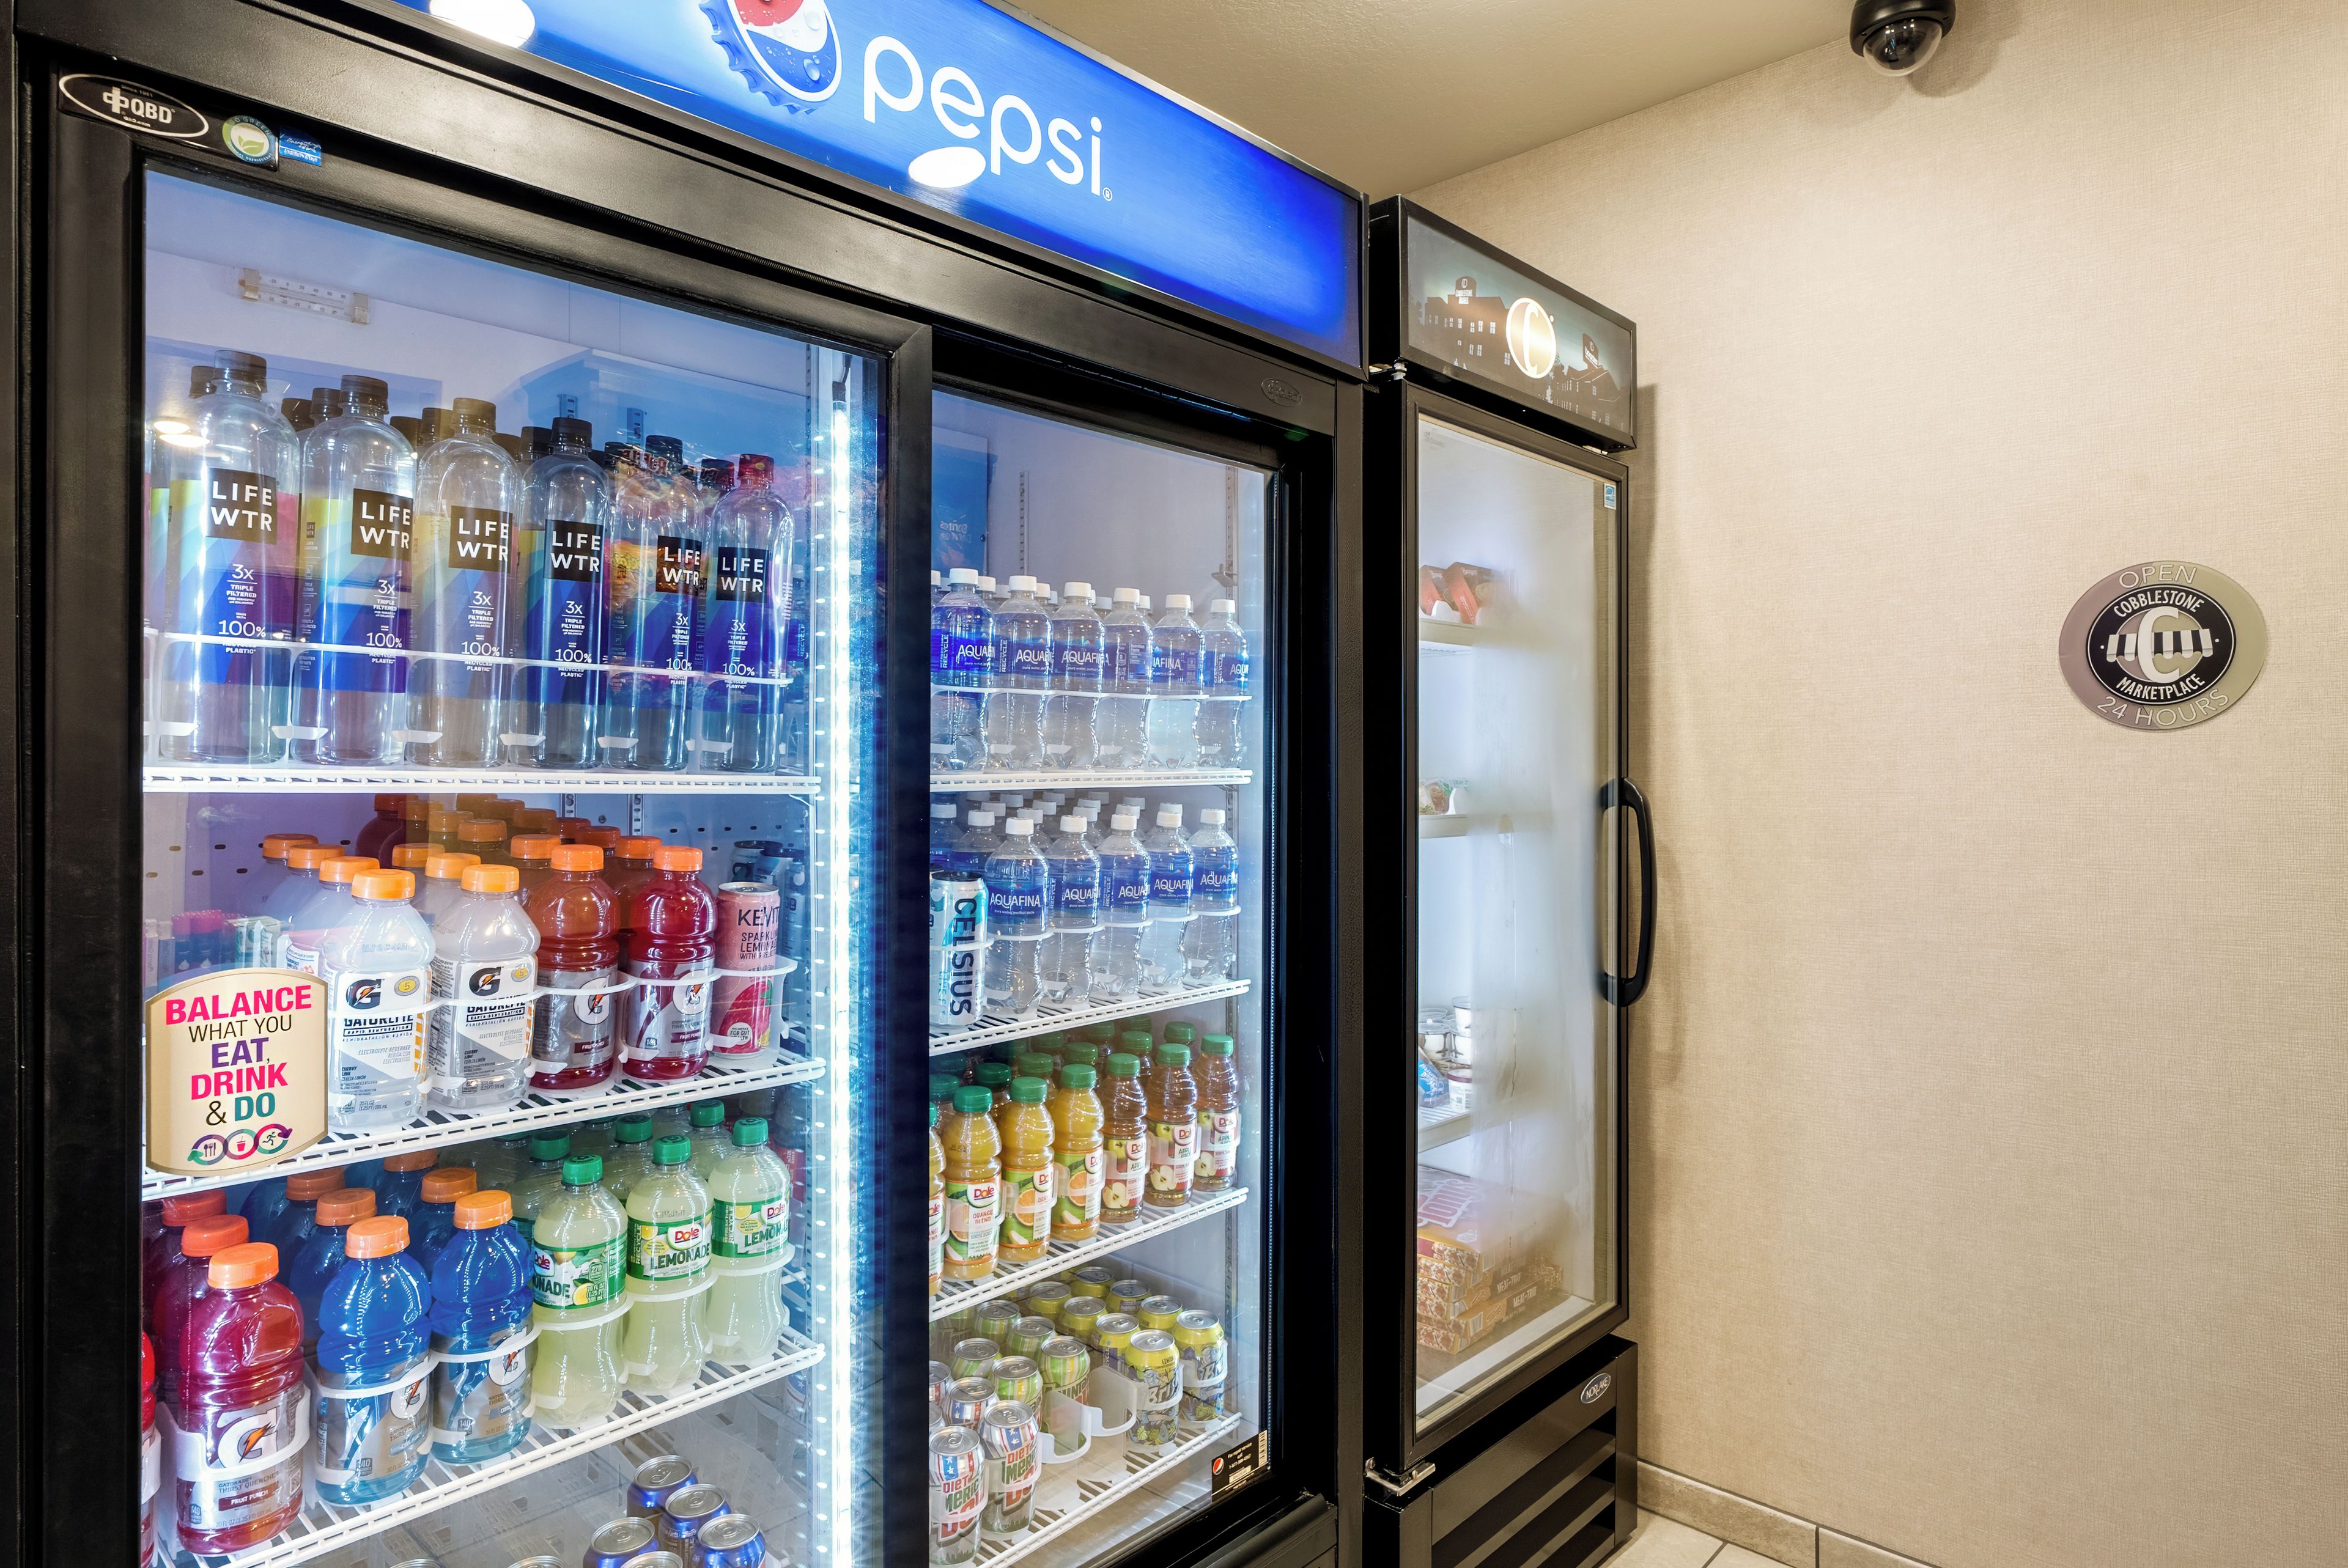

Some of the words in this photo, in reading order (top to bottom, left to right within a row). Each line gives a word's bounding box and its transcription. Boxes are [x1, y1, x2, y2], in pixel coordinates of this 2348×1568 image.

[130, 98, 172, 124] QBD
[863, 35, 1102, 196] pepsi
[212, 480, 272, 507] LIFE
[210, 506, 272, 532] WTR
[361, 501, 411, 526] LIFE
[360, 525, 410, 549] WTR
[459, 518, 509, 539] LIFE
[457, 540, 508, 562] WTR
[552, 531, 601, 551] LIFE
[550, 553, 600, 573] WTR
[664, 547, 700, 565] LIFE
[722, 557, 764, 573] LIFE
[232, 563, 254, 580] 3x
[663, 567, 700, 586] WTR
[2119, 564, 2197, 589] OPEN
[378, 580, 396, 595] 3x
[721, 576, 763, 593] WTR
[473, 591, 492, 606] 3x
[565, 600, 583, 614] 3x
[2113, 590, 2205, 617] COBBLESTONE
[218, 619, 267, 638] 100%
[675, 613, 689, 627] 3x
[731, 619, 746, 632] 3x
[366, 632, 402, 648] 100%
[461, 641, 500, 657] 100%
[2137, 606, 2180, 683] C
[555, 649, 592, 663] 100%
[666, 658, 692, 671] 100%
[722, 663, 755, 676] 100%
[2116, 673, 2206, 700] MARKETPLACE
[2097, 696, 2128, 720] 24
[2134, 688, 2229, 726] HOURS
[989, 893, 1041, 908] AQUAFINA
[738, 906, 780, 927] KEVIT
[950, 898, 977, 1016] CELSIUS
[165, 984, 312, 1025] BALANCE
[188, 1020, 248, 1043] WHAT
[254, 1014, 293, 1034] YOU
[212, 1037, 270, 1069] EAT,
[358, 1047, 388, 1056] ELECTROLYTE
[191, 1062, 288, 1100] DRINK
[206, 1100, 227, 1126] &
[234, 1092, 276, 1121] DO
[974, 1187, 994, 1199] Dole
[929, 1204, 940, 1215] ole
[973, 1209, 993, 1218] ORANGE
[674, 1228, 700, 1242] Dole
[534, 1251, 550, 1267] Dole
[651, 1243, 710, 1270] LEMONADE
[534, 1276, 570, 1298] ONADE
[1513, 1286, 1538, 1308] MEAT-TRIO
[231, 1496, 248, 1505] FRUIT
[249, 1490, 268, 1501] PUNCH
